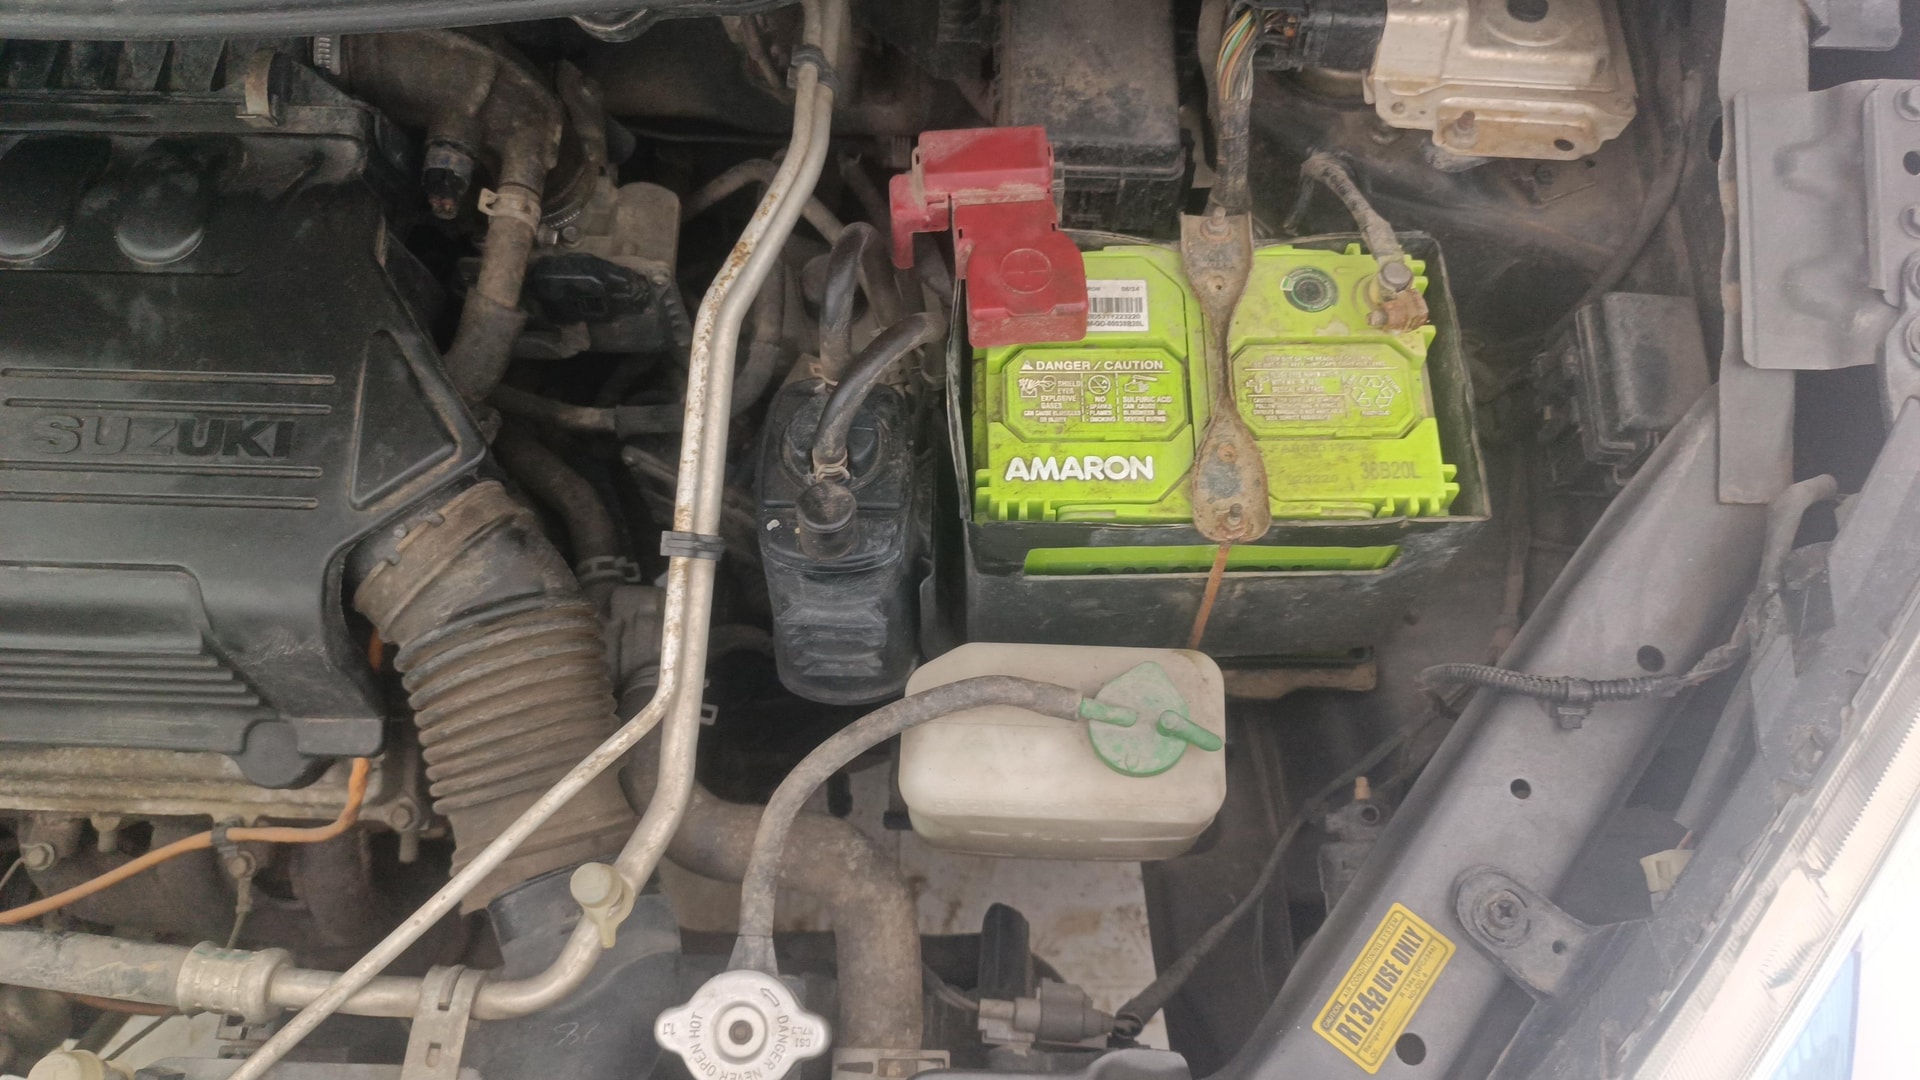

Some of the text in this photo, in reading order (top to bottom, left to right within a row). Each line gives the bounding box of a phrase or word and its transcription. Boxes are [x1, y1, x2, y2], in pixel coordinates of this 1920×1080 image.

[1036, 360, 1091, 371] DANGER
[1103, 360, 1163, 370] CAUTION
[32, 415, 296, 459] SUZUKI
[1005, 455, 1154, 481] AMARON
[1320, 916, 1400, 1029] CAUTION AIR CONDITIONING SYSTEM
[1333, 925, 1426, 1046] R134a USE ONLY
[689, 1012, 789, 1080] DANGER NEVER OPEN HOT
